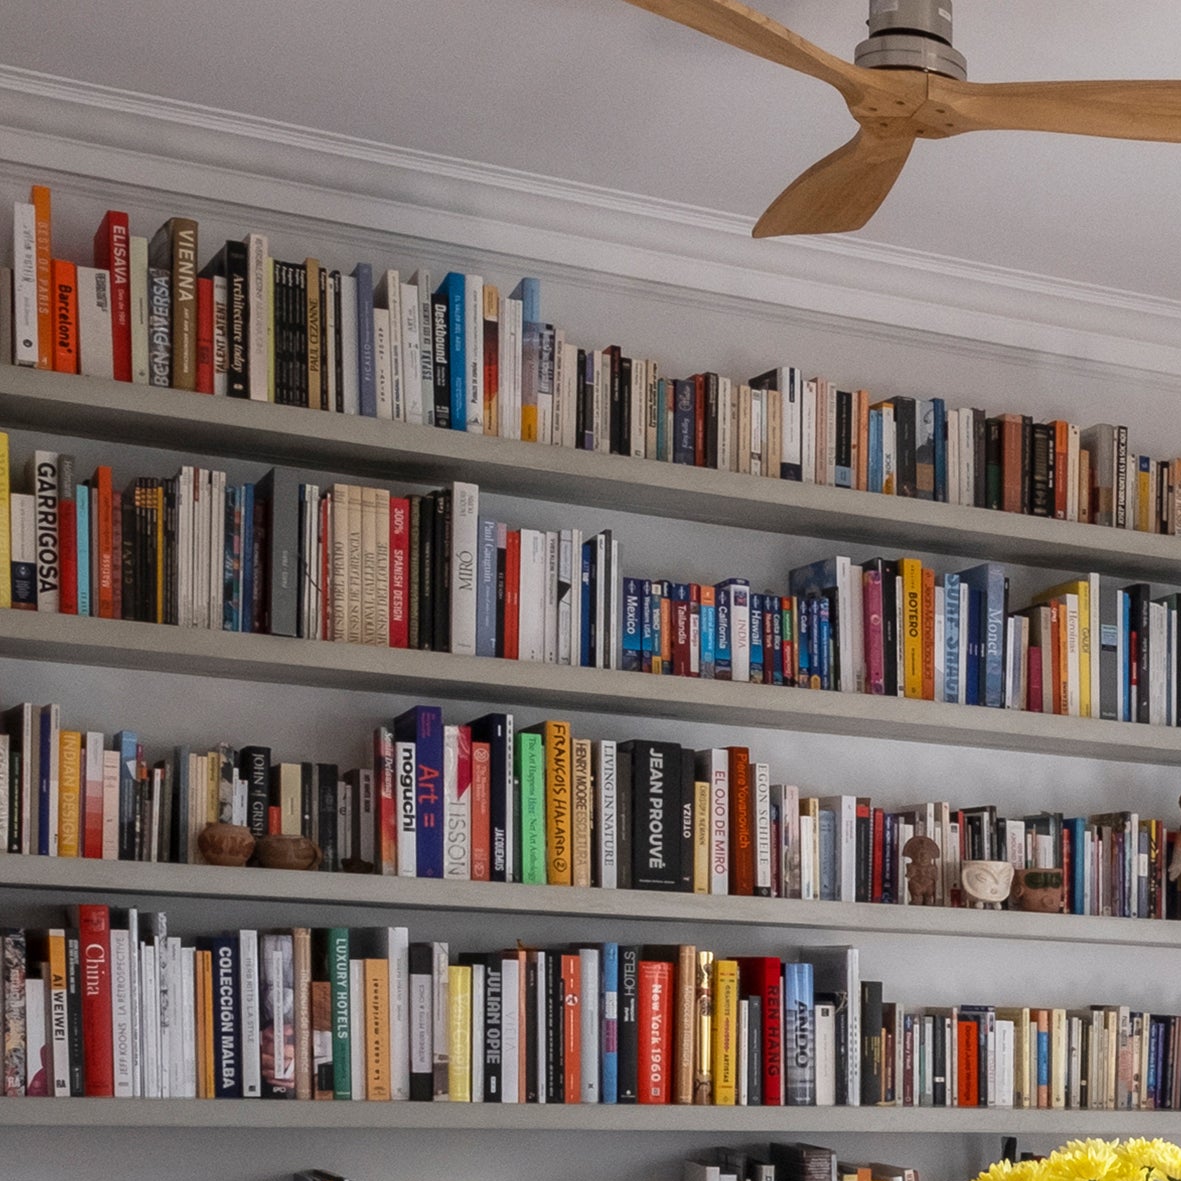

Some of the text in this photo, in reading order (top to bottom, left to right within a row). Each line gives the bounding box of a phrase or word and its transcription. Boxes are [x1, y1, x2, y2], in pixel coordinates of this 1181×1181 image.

[39, 221, 48, 314] BEST OF PARIS
[113, 225, 126, 284] ELISAVA
[178, 229, 194, 302] VIENNA
[215, 301, 227, 374] TALENT LATENT
[228, 274, 244, 373] Architecture today
[309, 297, 319, 373] PAUL CEZANNE
[434, 304, 447, 364] Deskbound
[363, 344, 371, 381] PICASSO
[38, 460, 57, 592] GARRIGOSA
[483, 520, 495, 583] Paul Gauguin
[102, 554, 110, 588] Matisse
[351, 531, 360, 585] FLORENCIA
[377, 544, 387, 581] LOUVRE
[393, 508, 404, 621] 300% SPANISH DESIGN
[456, 551, 473, 591] MIRÓ
[334, 541, 345, 641] MUSEO DEL PRADO
[364, 551, 374, 645] NATIONAL GALLERY
[626, 595, 638, 635] Mexico
[643, 596, 651, 638] Western USA
[908, 592, 918, 638] BOTERO
[377, 606, 387, 645] MUSEO
[677, 604, 687, 645] Tailandia
[690, 630, 698, 647] Diego
[718, 606, 728, 649] California
[738, 619, 747, 648] INDIA
[751, 609, 761, 645] Hawaii
[773, 613, 781, 650] Costa Rica
[800, 615, 808, 633] Cuba
[988, 607, 1002, 656] Monet
[253, 752, 265, 785] JOHN
[382, 731, 394, 799] Sonia Delaunay
[418, 764, 439, 805] Art
[529, 752, 537, 765] Art
[529, 765, 537, 796] Happens
[62, 734, 75, 846] INDIAN DESIGN
[400, 748, 416, 832] noguchi
[553, 723, 567, 856] FRANÇOIS HALARD
[576, 742, 587, 866] HENRY MOORE ESCULTURA
[604, 744, 614, 867] LIVING IN NATURE
[649, 747, 666, 870] JEAN PROUVÉ
[699, 785, 707, 846] CHRISTOPH NIEMANN
[736, 752, 750, 849] Pierre Yovanovitch
[758, 764, 769, 866] EGON SCHIELE
[494, 826, 505, 871] JACQUEMUS
[529, 818, 537, 832] Net
[529, 832, 537, 845] Art
[683, 803, 691, 839] OTEIZA
[715, 770, 727, 875] EL OJO DE MIRÓ
[528, 845, 537, 881] Anthology
[85, 943, 105, 997] China
[245, 958, 254, 979] HERB
[335, 938, 347, 1039] LUXURY HOTELS
[623, 951, 635, 996] HOTELS
[53, 974, 65, 1041] AI WEIWEI
[115, 936, 128, 1076] JEFF KOONS LA RÉTROSPECTIVE
[219, 947, 235, 1089] COLECCIÓN MALBA
[245, 1020, 254, 1044] STYLE
[487, 967, 501, 1064] JULIAN OPIE
[651, 984, 661, 1083] New York 1960
[767, 985, 779, 1077] REN HANG
[796, 1000, 808, 1069] ANDO
[301, 1030, 310, 1074] Provence
[962, 1025, 972, 1102] Donald Judd Writings
